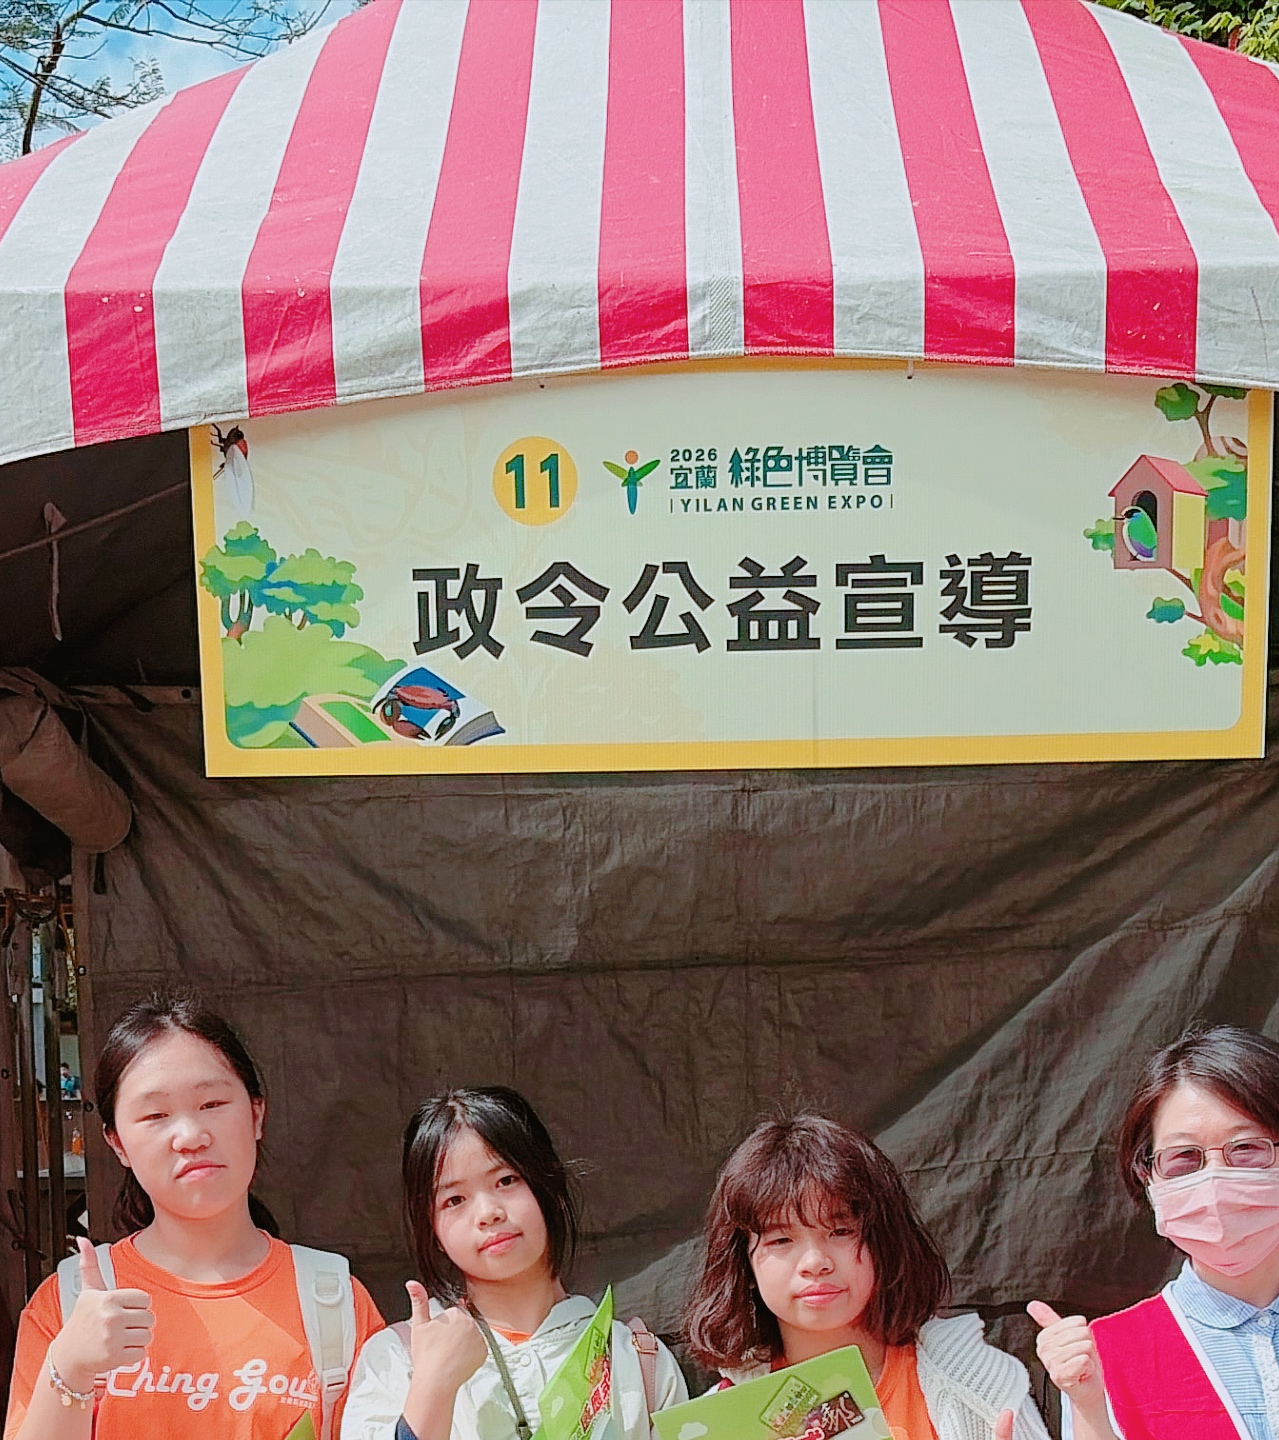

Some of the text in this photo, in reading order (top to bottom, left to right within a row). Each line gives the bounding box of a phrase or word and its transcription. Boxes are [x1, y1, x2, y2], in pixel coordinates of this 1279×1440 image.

[670, 448, 718, 463] 2026
[727, 444, 893, 488] 綠色博覽會
[505, 452, 561, 510] 11
[669, 465, 717, 490] 宜蘭
[680, 494, 883, 514] YILAN GREEN EXPO
[411, 550, 1033, 659] 政令公益宣導
